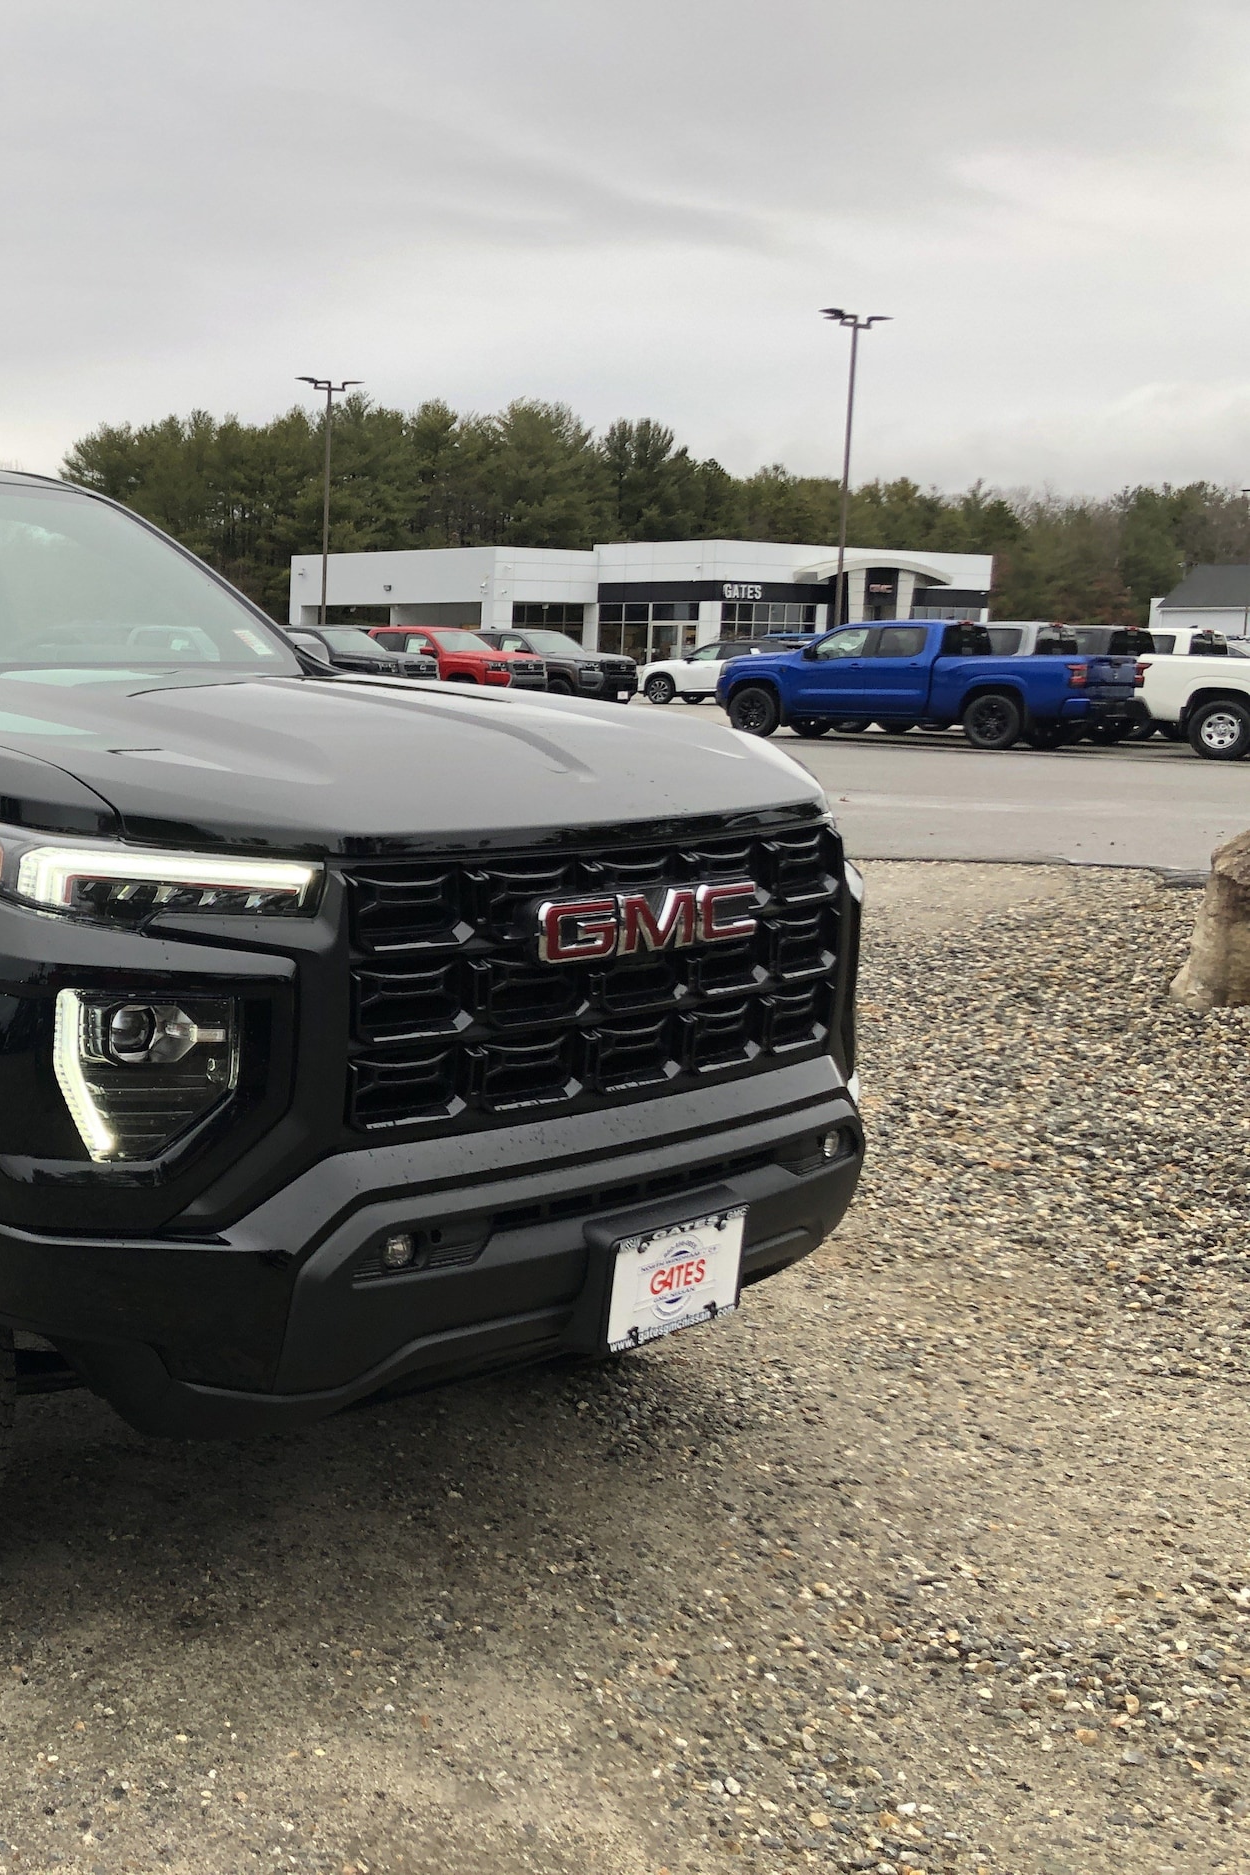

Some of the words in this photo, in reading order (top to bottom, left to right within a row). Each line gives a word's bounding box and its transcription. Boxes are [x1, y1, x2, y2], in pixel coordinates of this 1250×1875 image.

[723, 583, 762, 600] GATES
[537, 880, 758, 964] GMC
[652, 1216, 720, 1240] GATES
[649, 1258, 706, 1295] GATES
